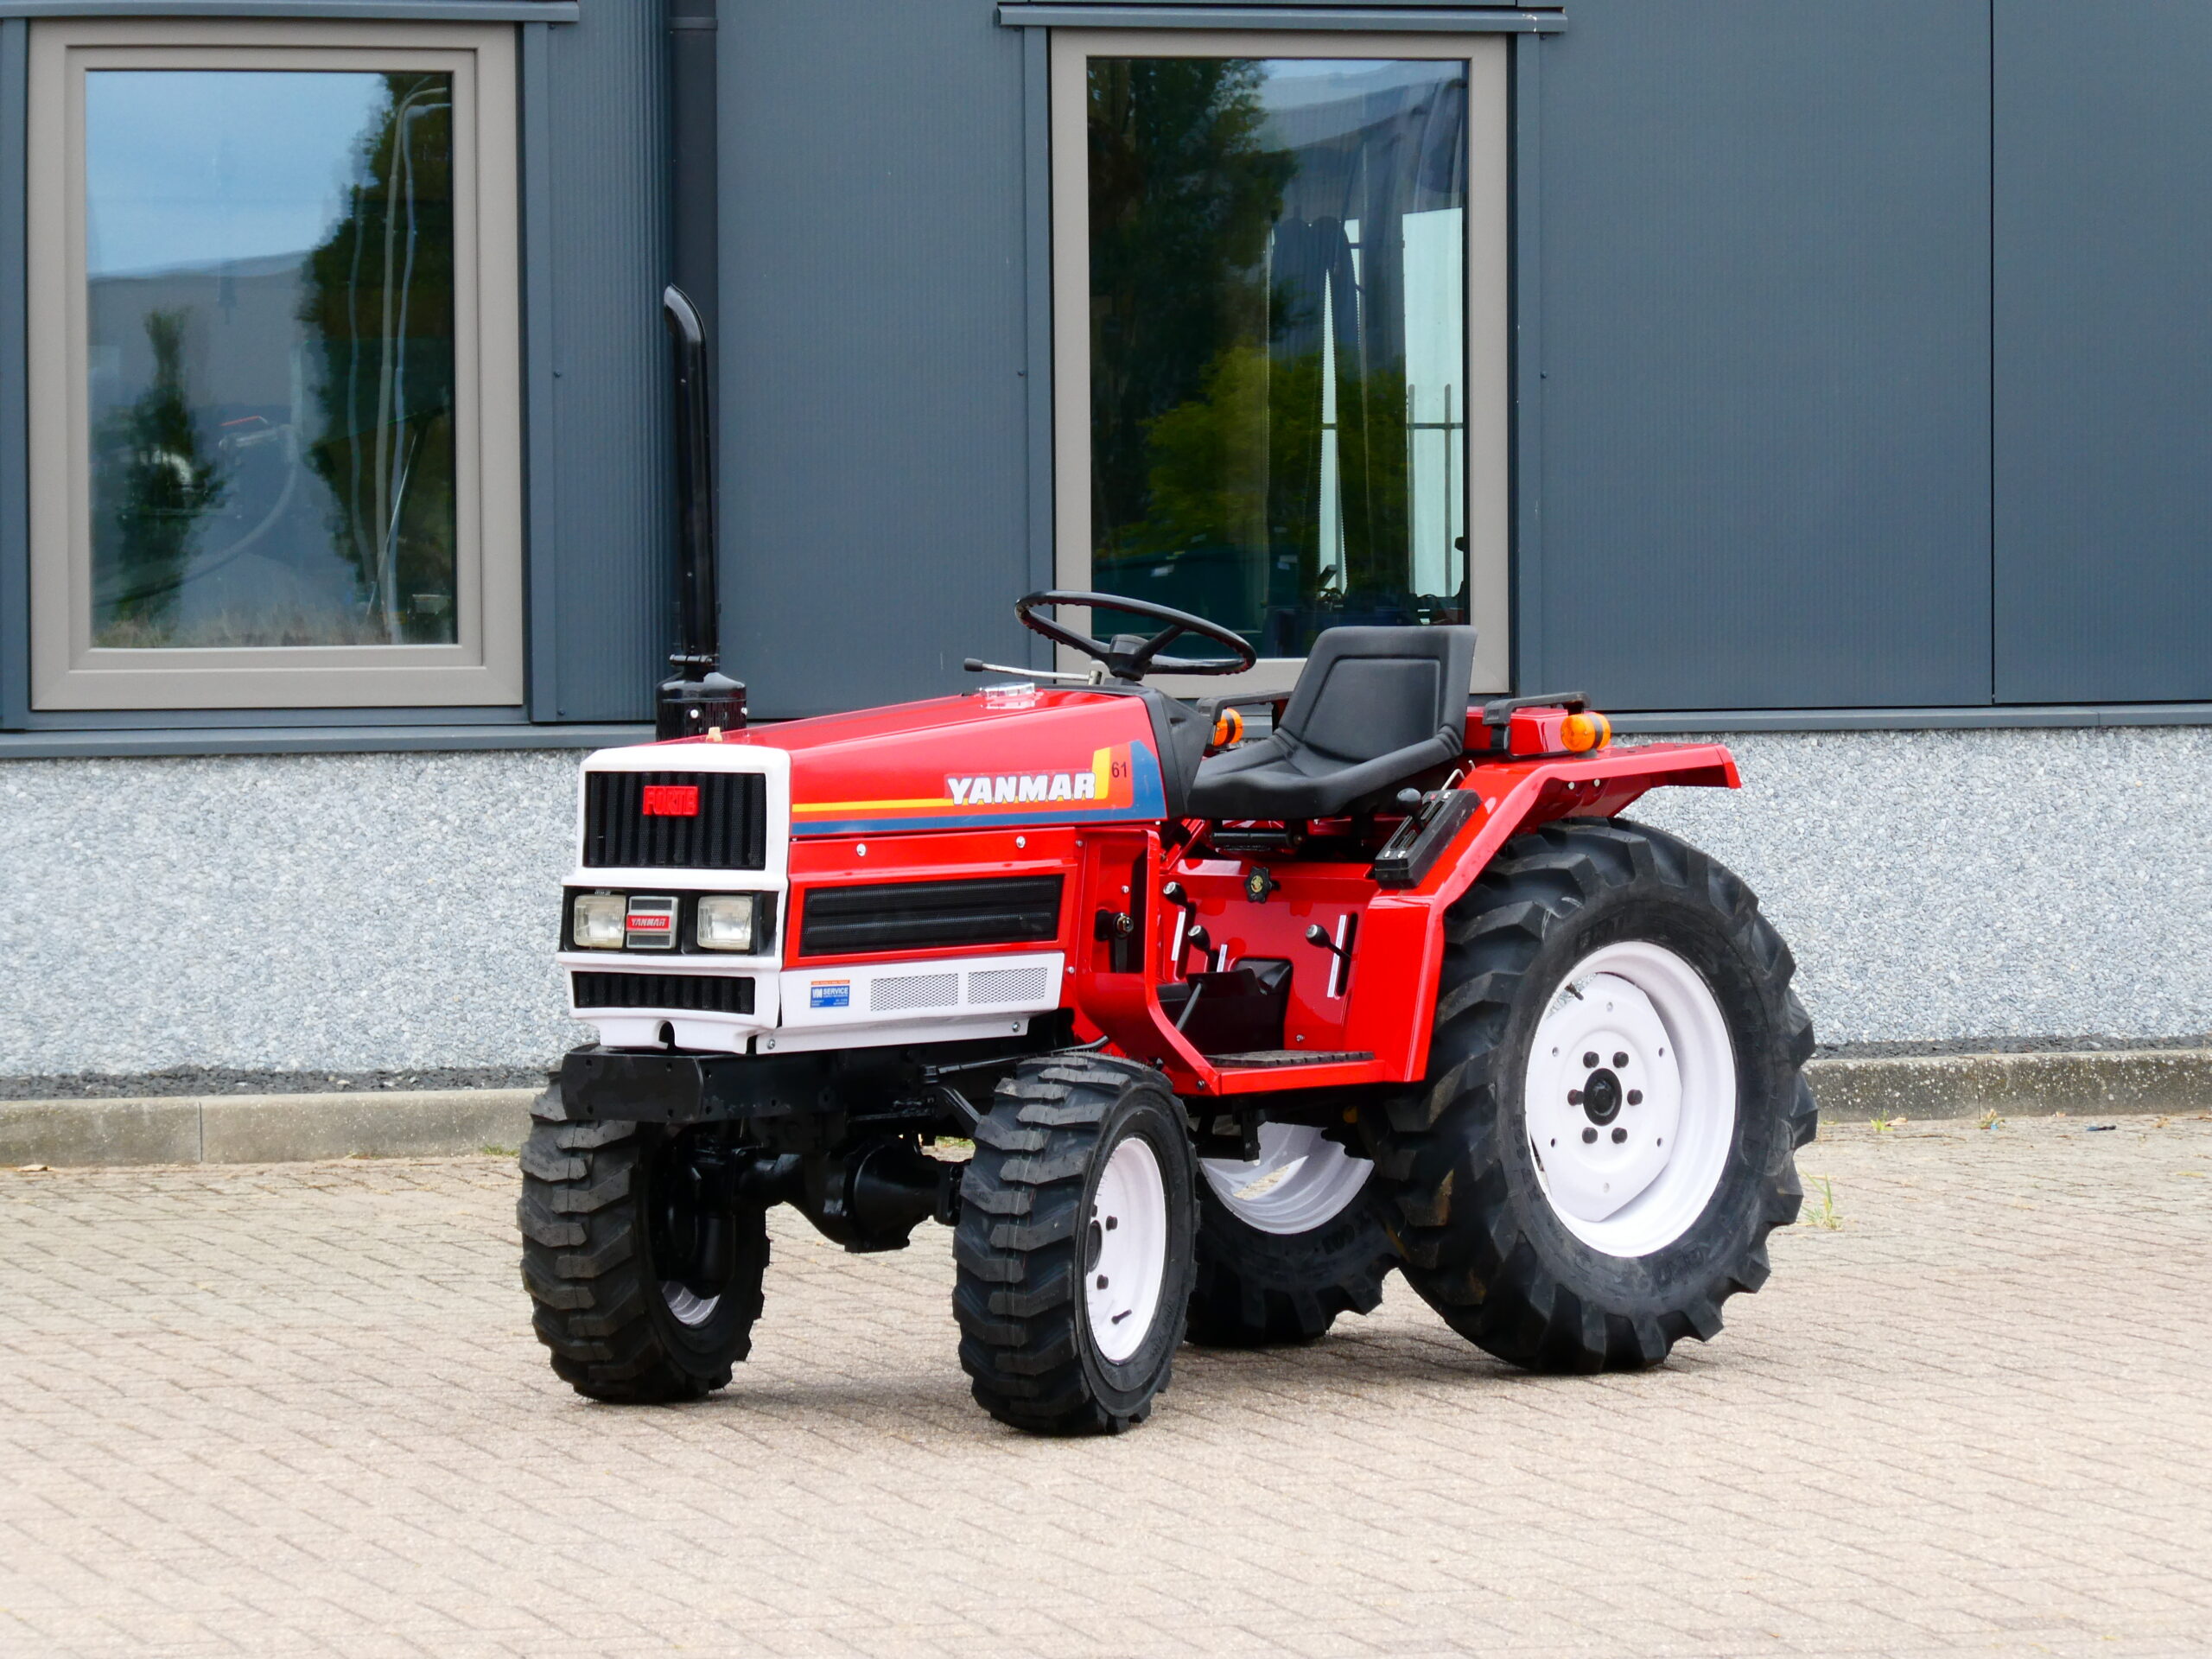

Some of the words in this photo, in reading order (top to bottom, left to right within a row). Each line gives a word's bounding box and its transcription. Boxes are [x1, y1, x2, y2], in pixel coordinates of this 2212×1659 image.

[1111, 761, 1128, 779] 61
[643, 785, 698, 816] FORTE
[947, 772, 1096, 805] YANMAR
[631, 918, 666, 927] YANMAR
